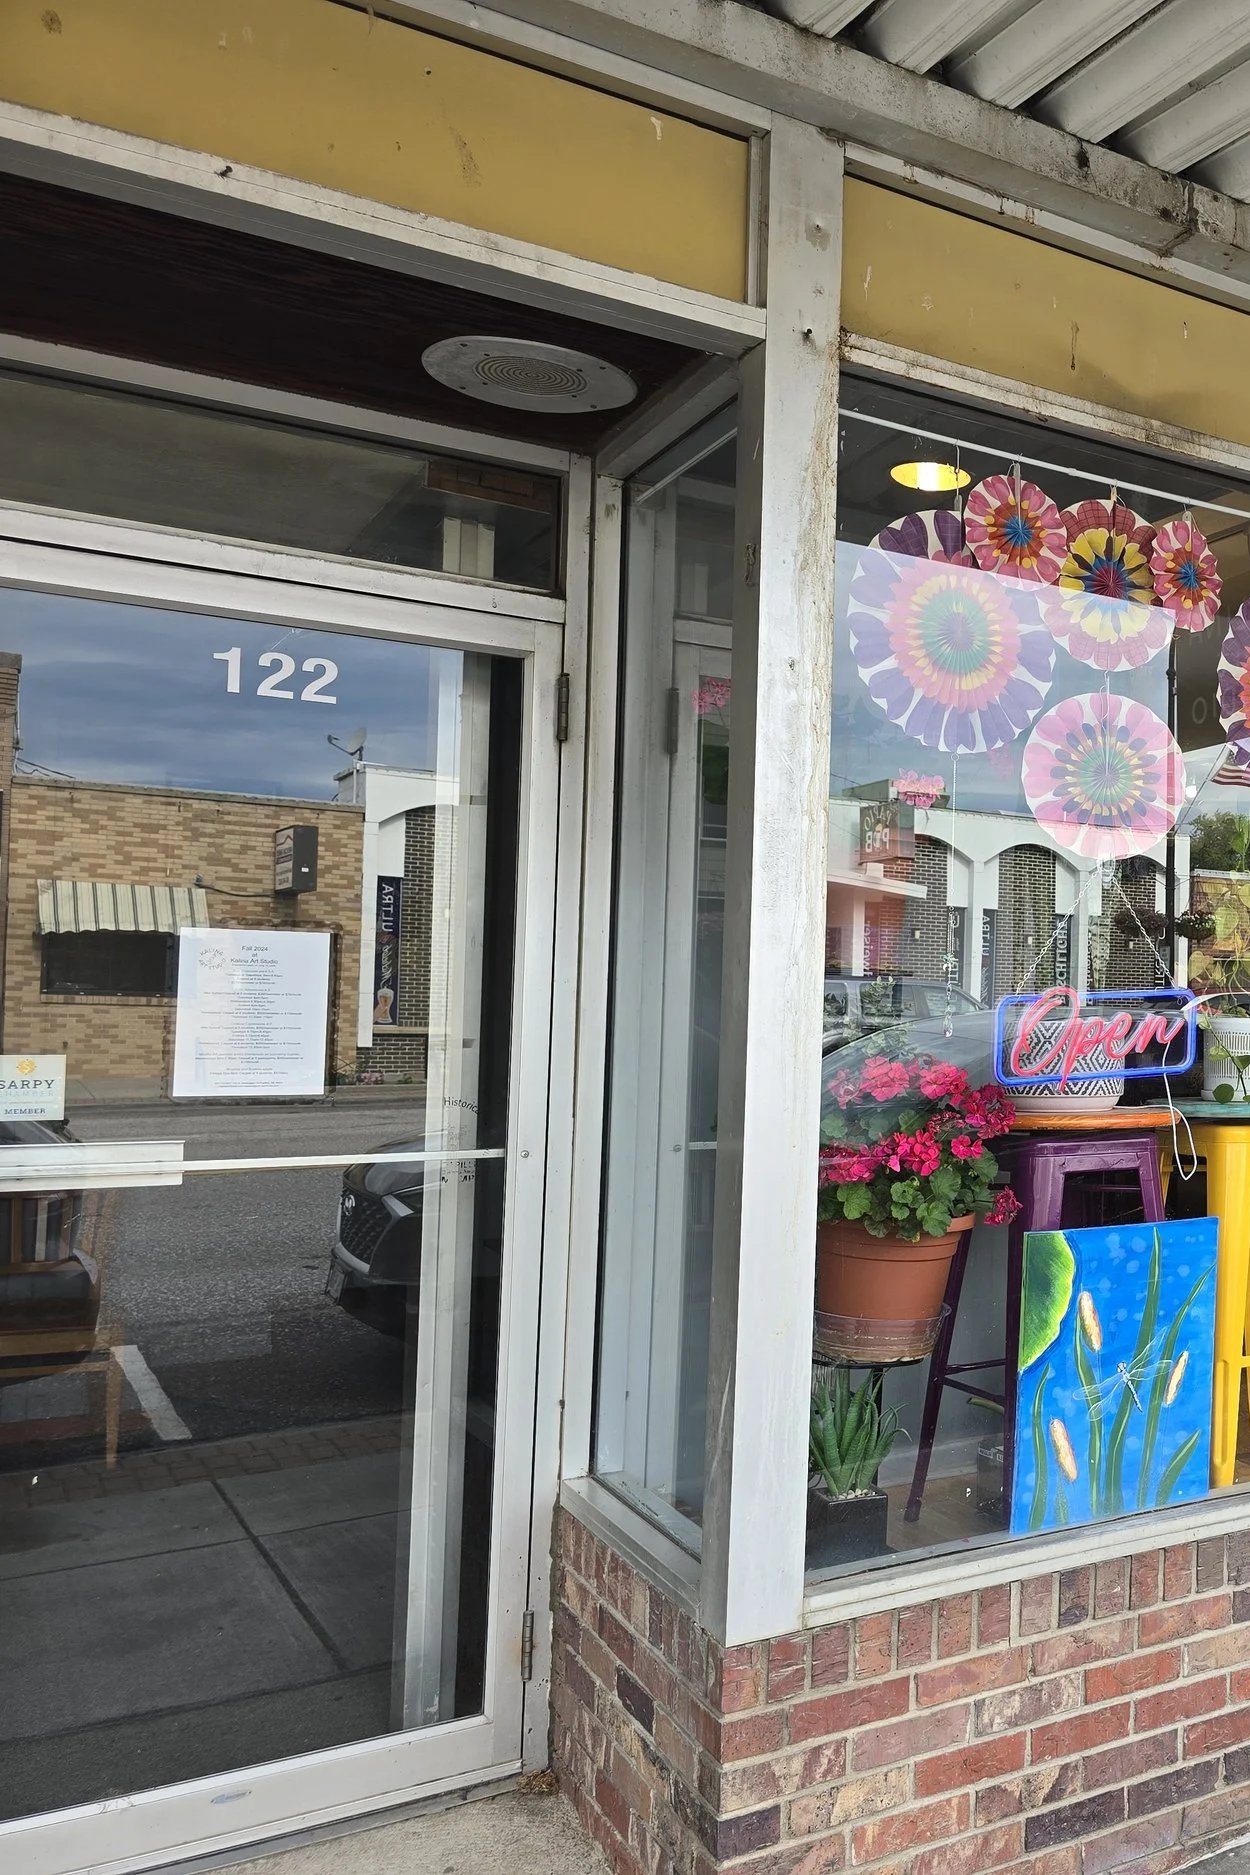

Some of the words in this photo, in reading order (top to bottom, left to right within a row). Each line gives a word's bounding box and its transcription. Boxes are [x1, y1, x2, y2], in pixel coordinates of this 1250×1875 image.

[212, 646, 339, 705] 122
[1009, 986, 1186, 1093] Open
[0, 1079, 55, 1090] SARPY
